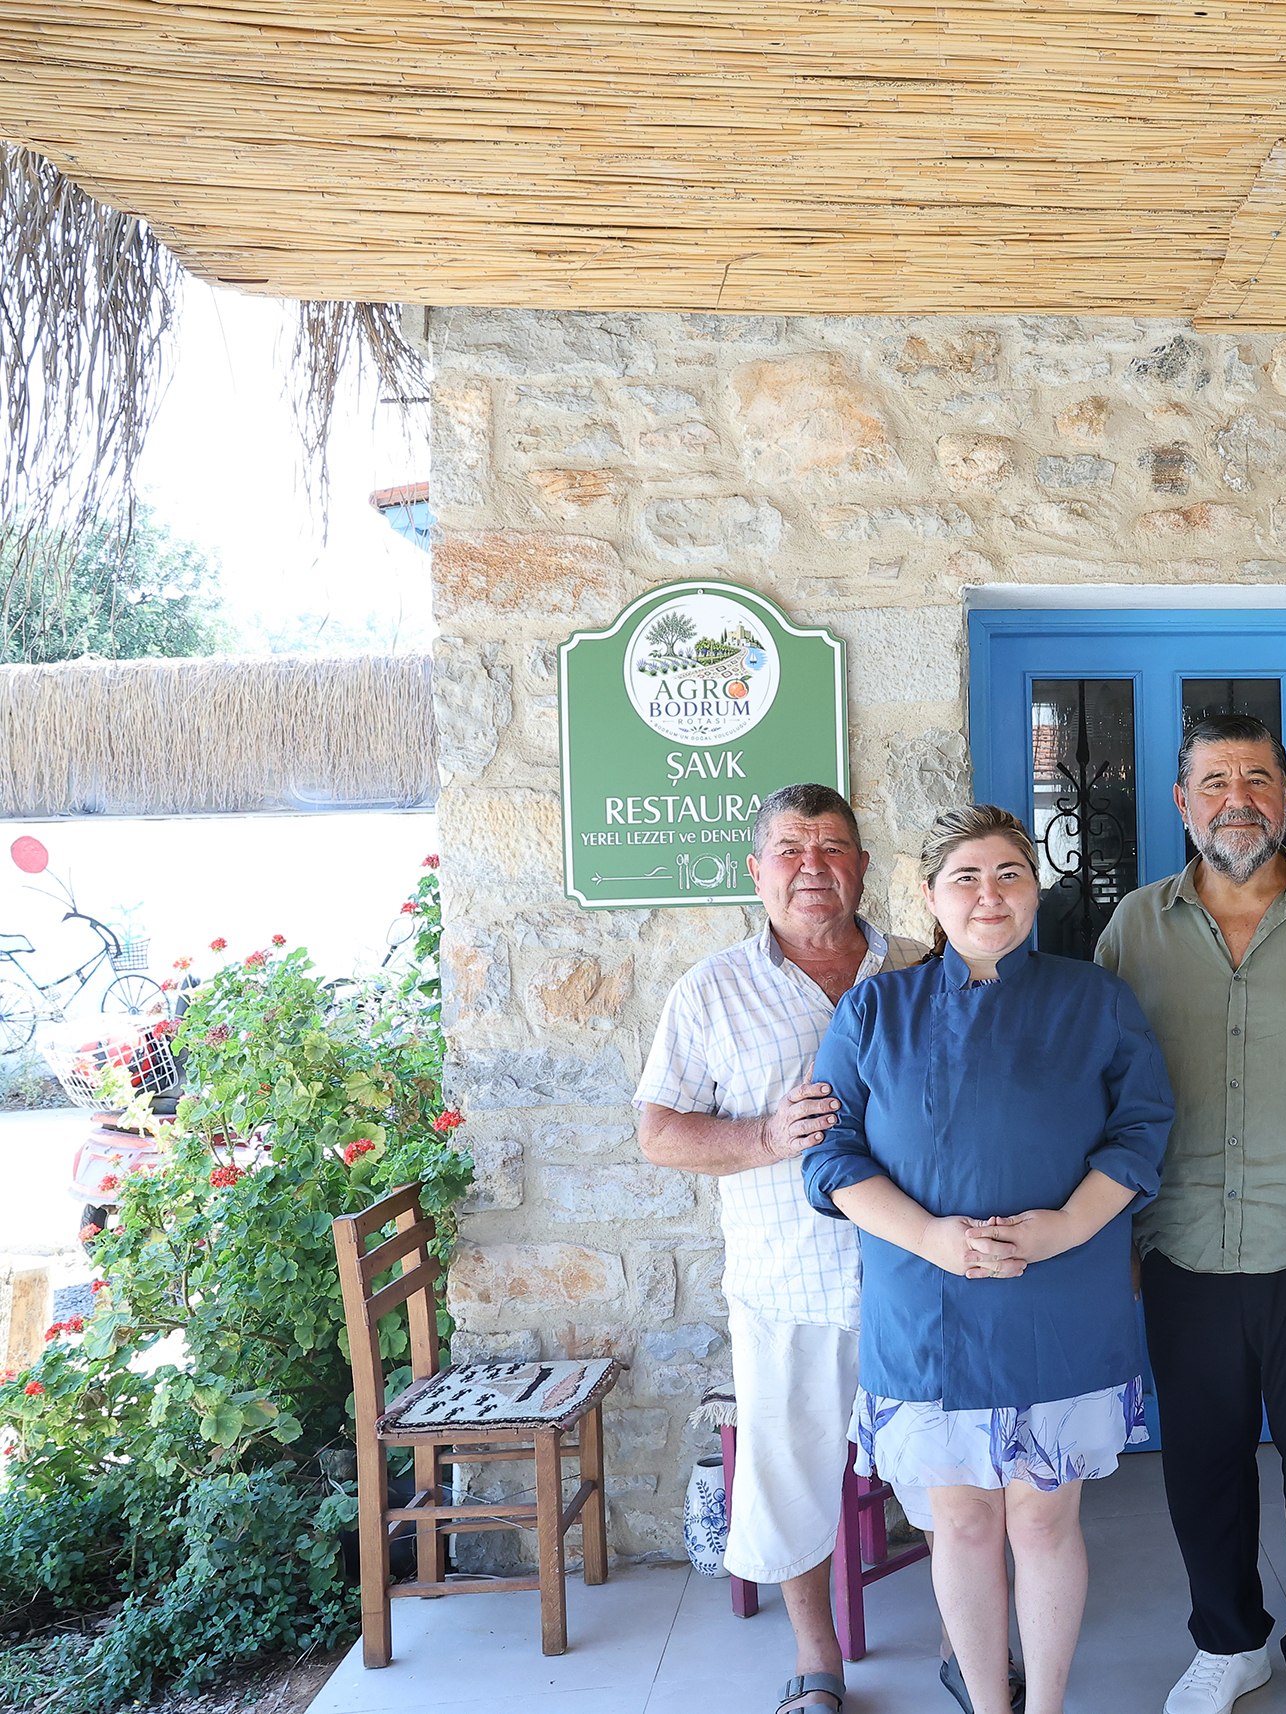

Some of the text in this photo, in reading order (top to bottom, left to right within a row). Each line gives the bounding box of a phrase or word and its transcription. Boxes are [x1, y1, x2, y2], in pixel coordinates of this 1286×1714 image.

[655, 679, 749, 700] AGRO
[650, 701, 750, 717] BODRUM
[677, 717, 726, 725] ROTASI
[666, 750, 747, 787] ŞAVK
[605, 794, 763, 825] RESTAURA
[581, 826, 755, 846] YEREL LEZZET ve DENEYİ
